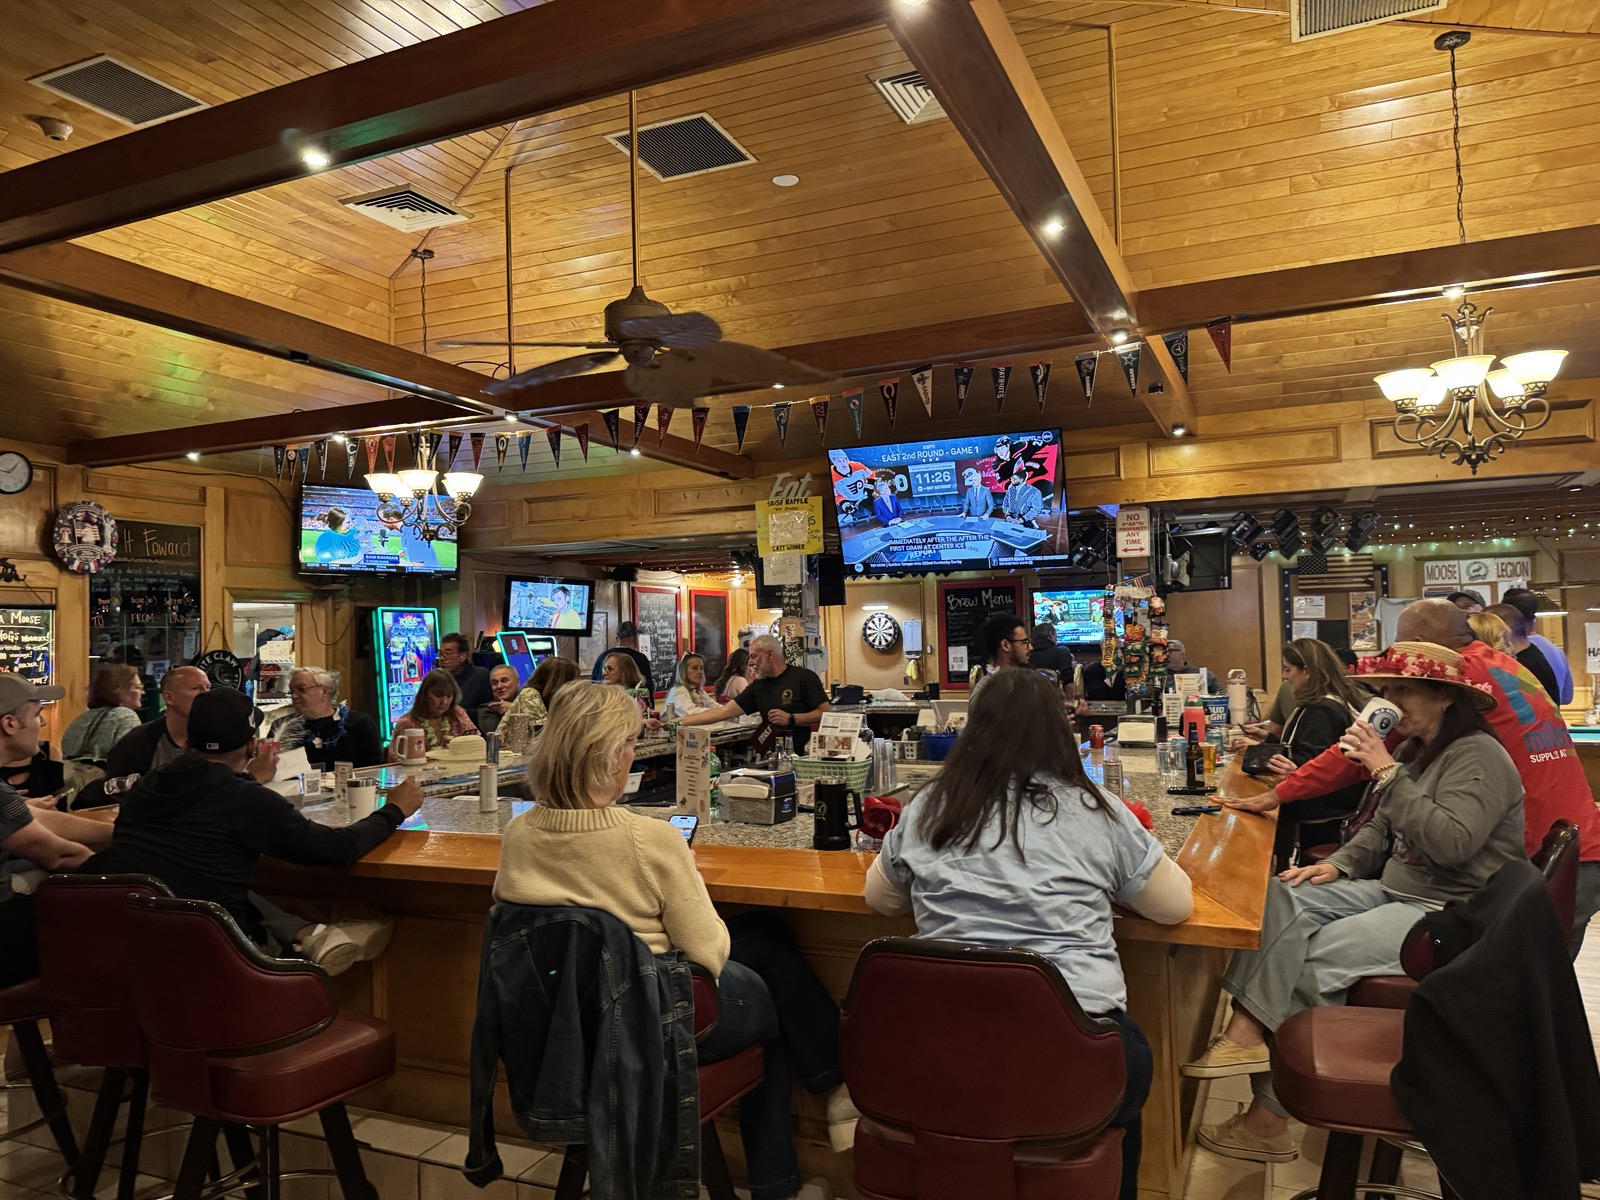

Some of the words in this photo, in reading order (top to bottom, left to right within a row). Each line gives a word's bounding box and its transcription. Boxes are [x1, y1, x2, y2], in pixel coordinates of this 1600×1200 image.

[996, 366, 1006, 399] PATRIOTS
[921, 385, 931, 406] SAINTS
[881, 453, 901, 463] EAST
[901, 452, 917, 460] 2nd
[916, 448, 945, 459] ROUND
[950, 446, 973, 455] GAME
[974, 445, 979, 454] 1
[769, 471, 814, 500] Eat
[894, 473, 909, 491] 0
[915, 470, 951, 484] 11:26
[784, 497, 809, 506] RAFFLE
[1126, 513, 1140, 522] NO
[142, 528, 192, 557] Foward
[772, 544, 786, 552] LAST
[786, 543, 806, 551] WINNER
[1425, 564, 1458, 581] MOOSE
[1496, 560, 1530, 578] LEGION
[946, 594, 979, 610] Brew
[981, 588, 1014, 609] Menu
[131, 613, 154, 624] FROM
[213, 652, 239, 668] CLAW
